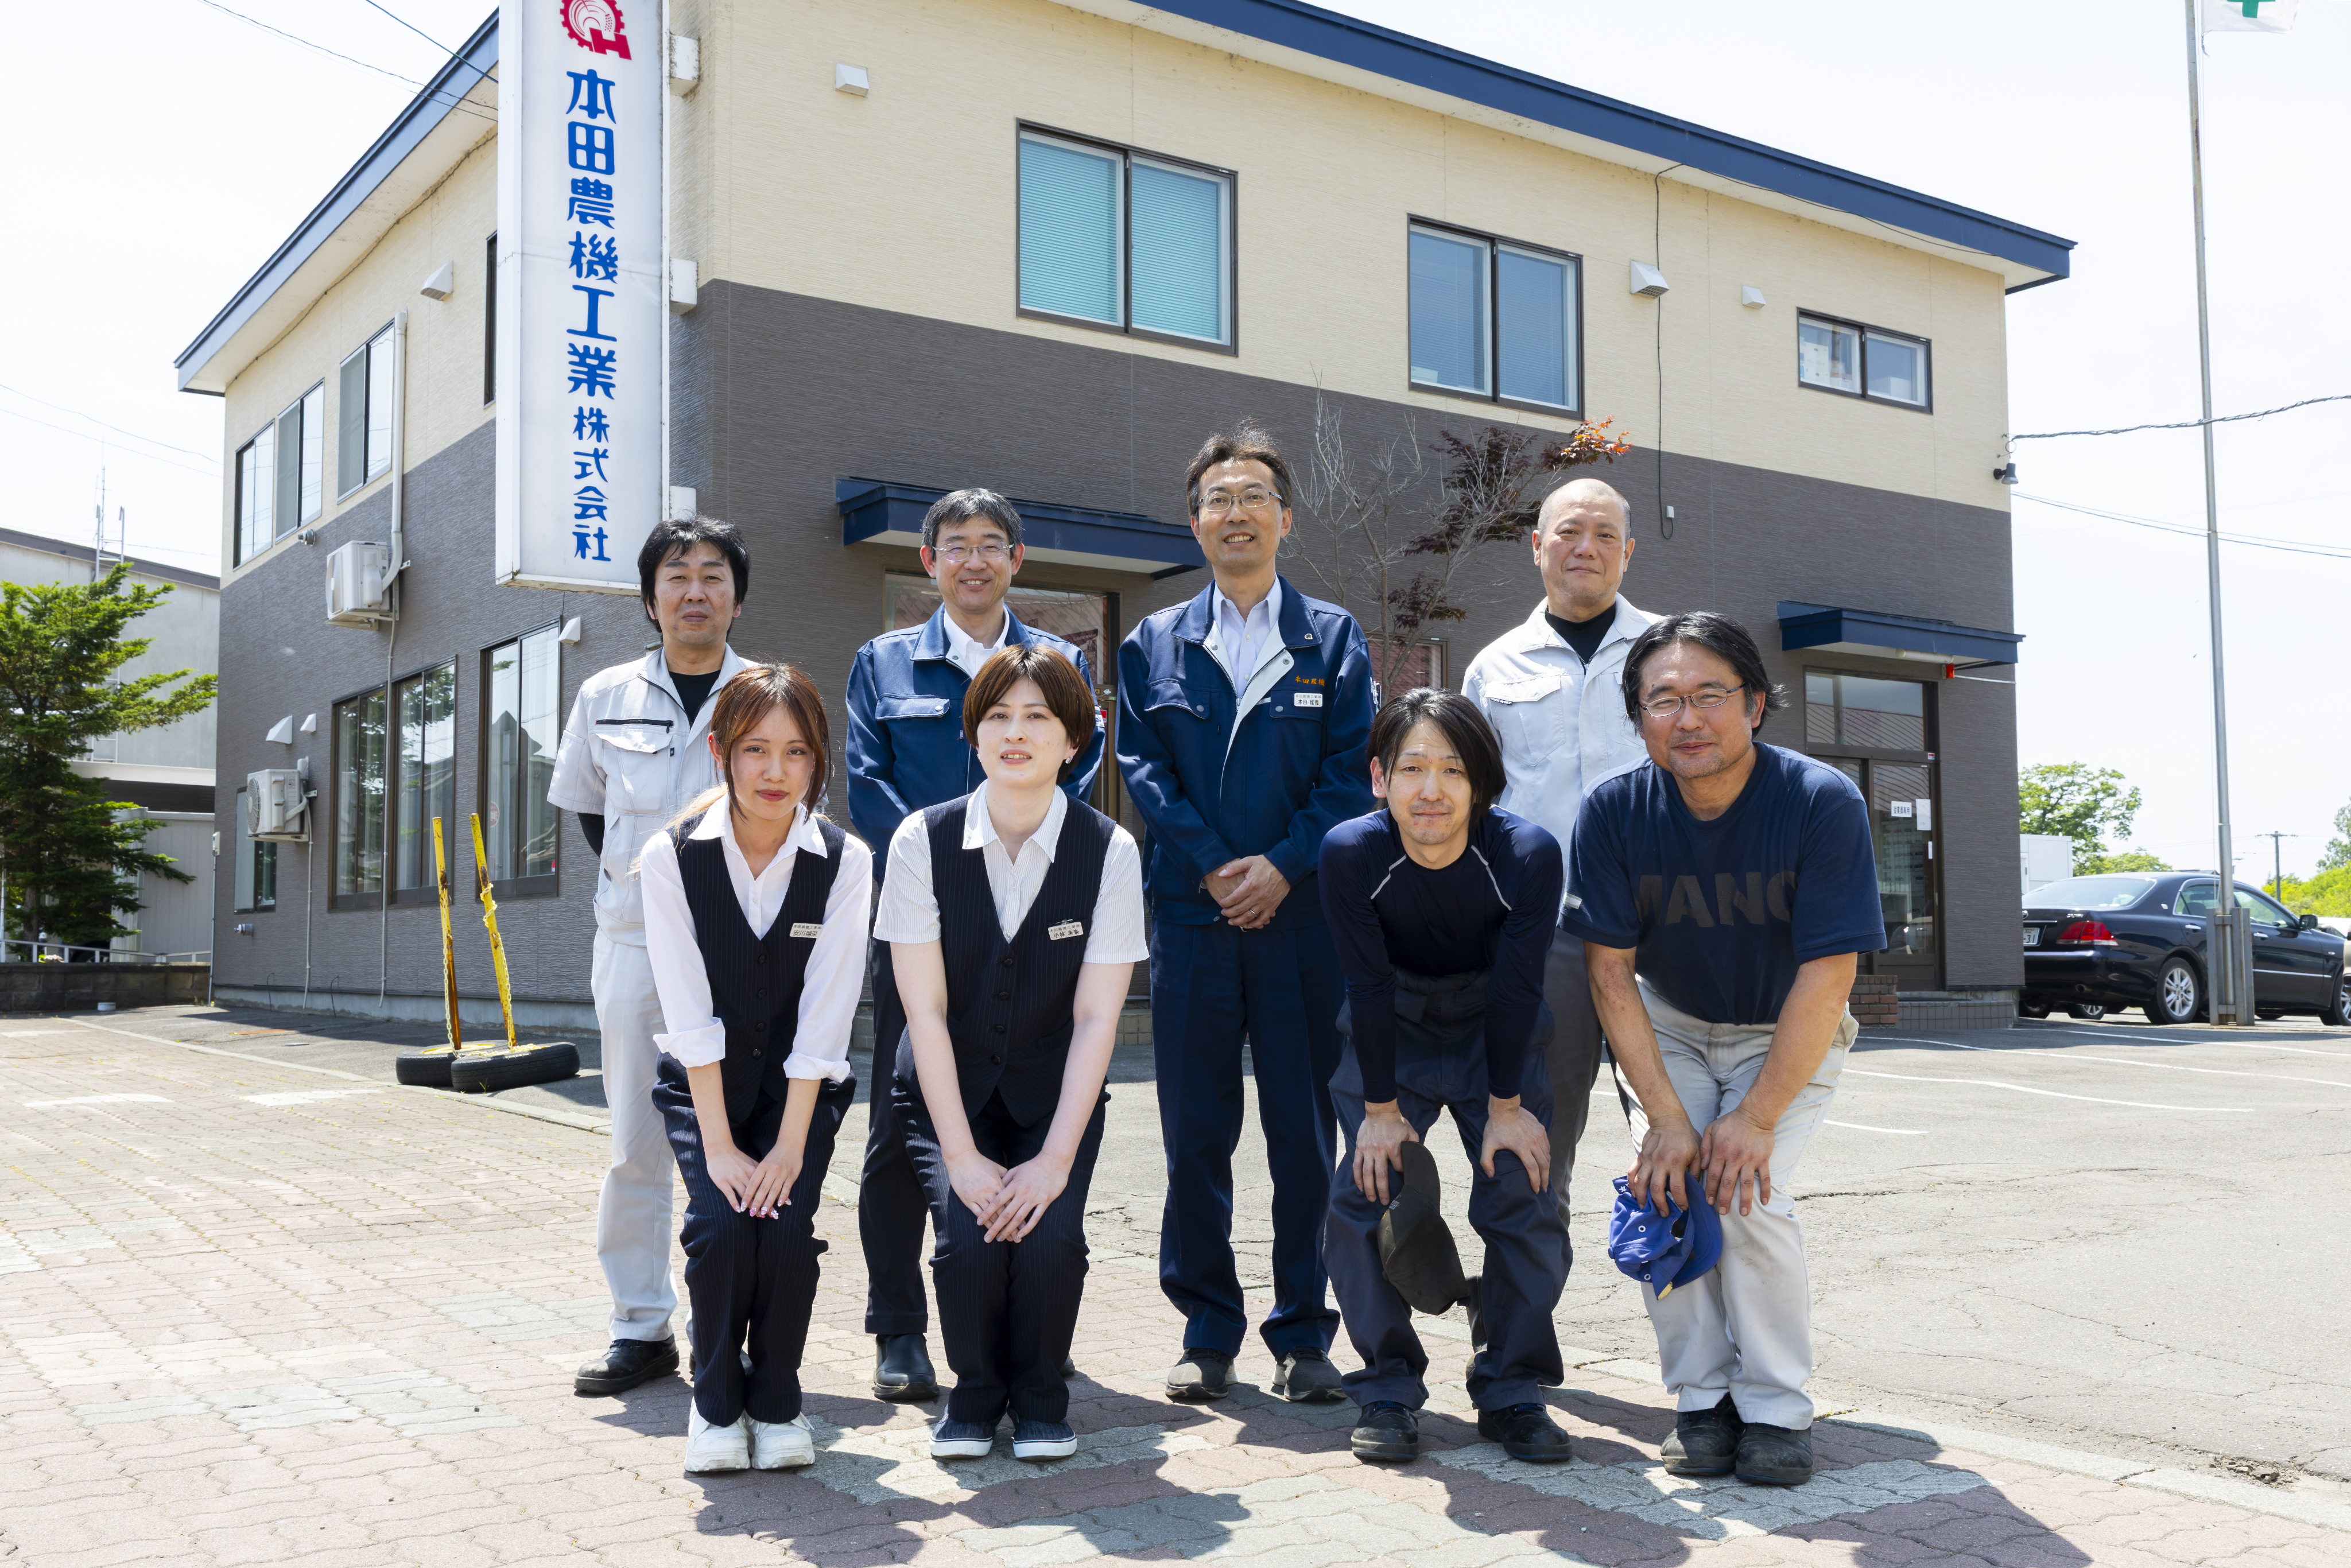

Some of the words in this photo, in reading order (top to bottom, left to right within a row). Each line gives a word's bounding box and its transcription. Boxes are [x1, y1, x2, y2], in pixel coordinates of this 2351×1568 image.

[566, 69, 619, 562] 本田農機工業株式会社
[1295, 676, 1325, 686] 本田農機
